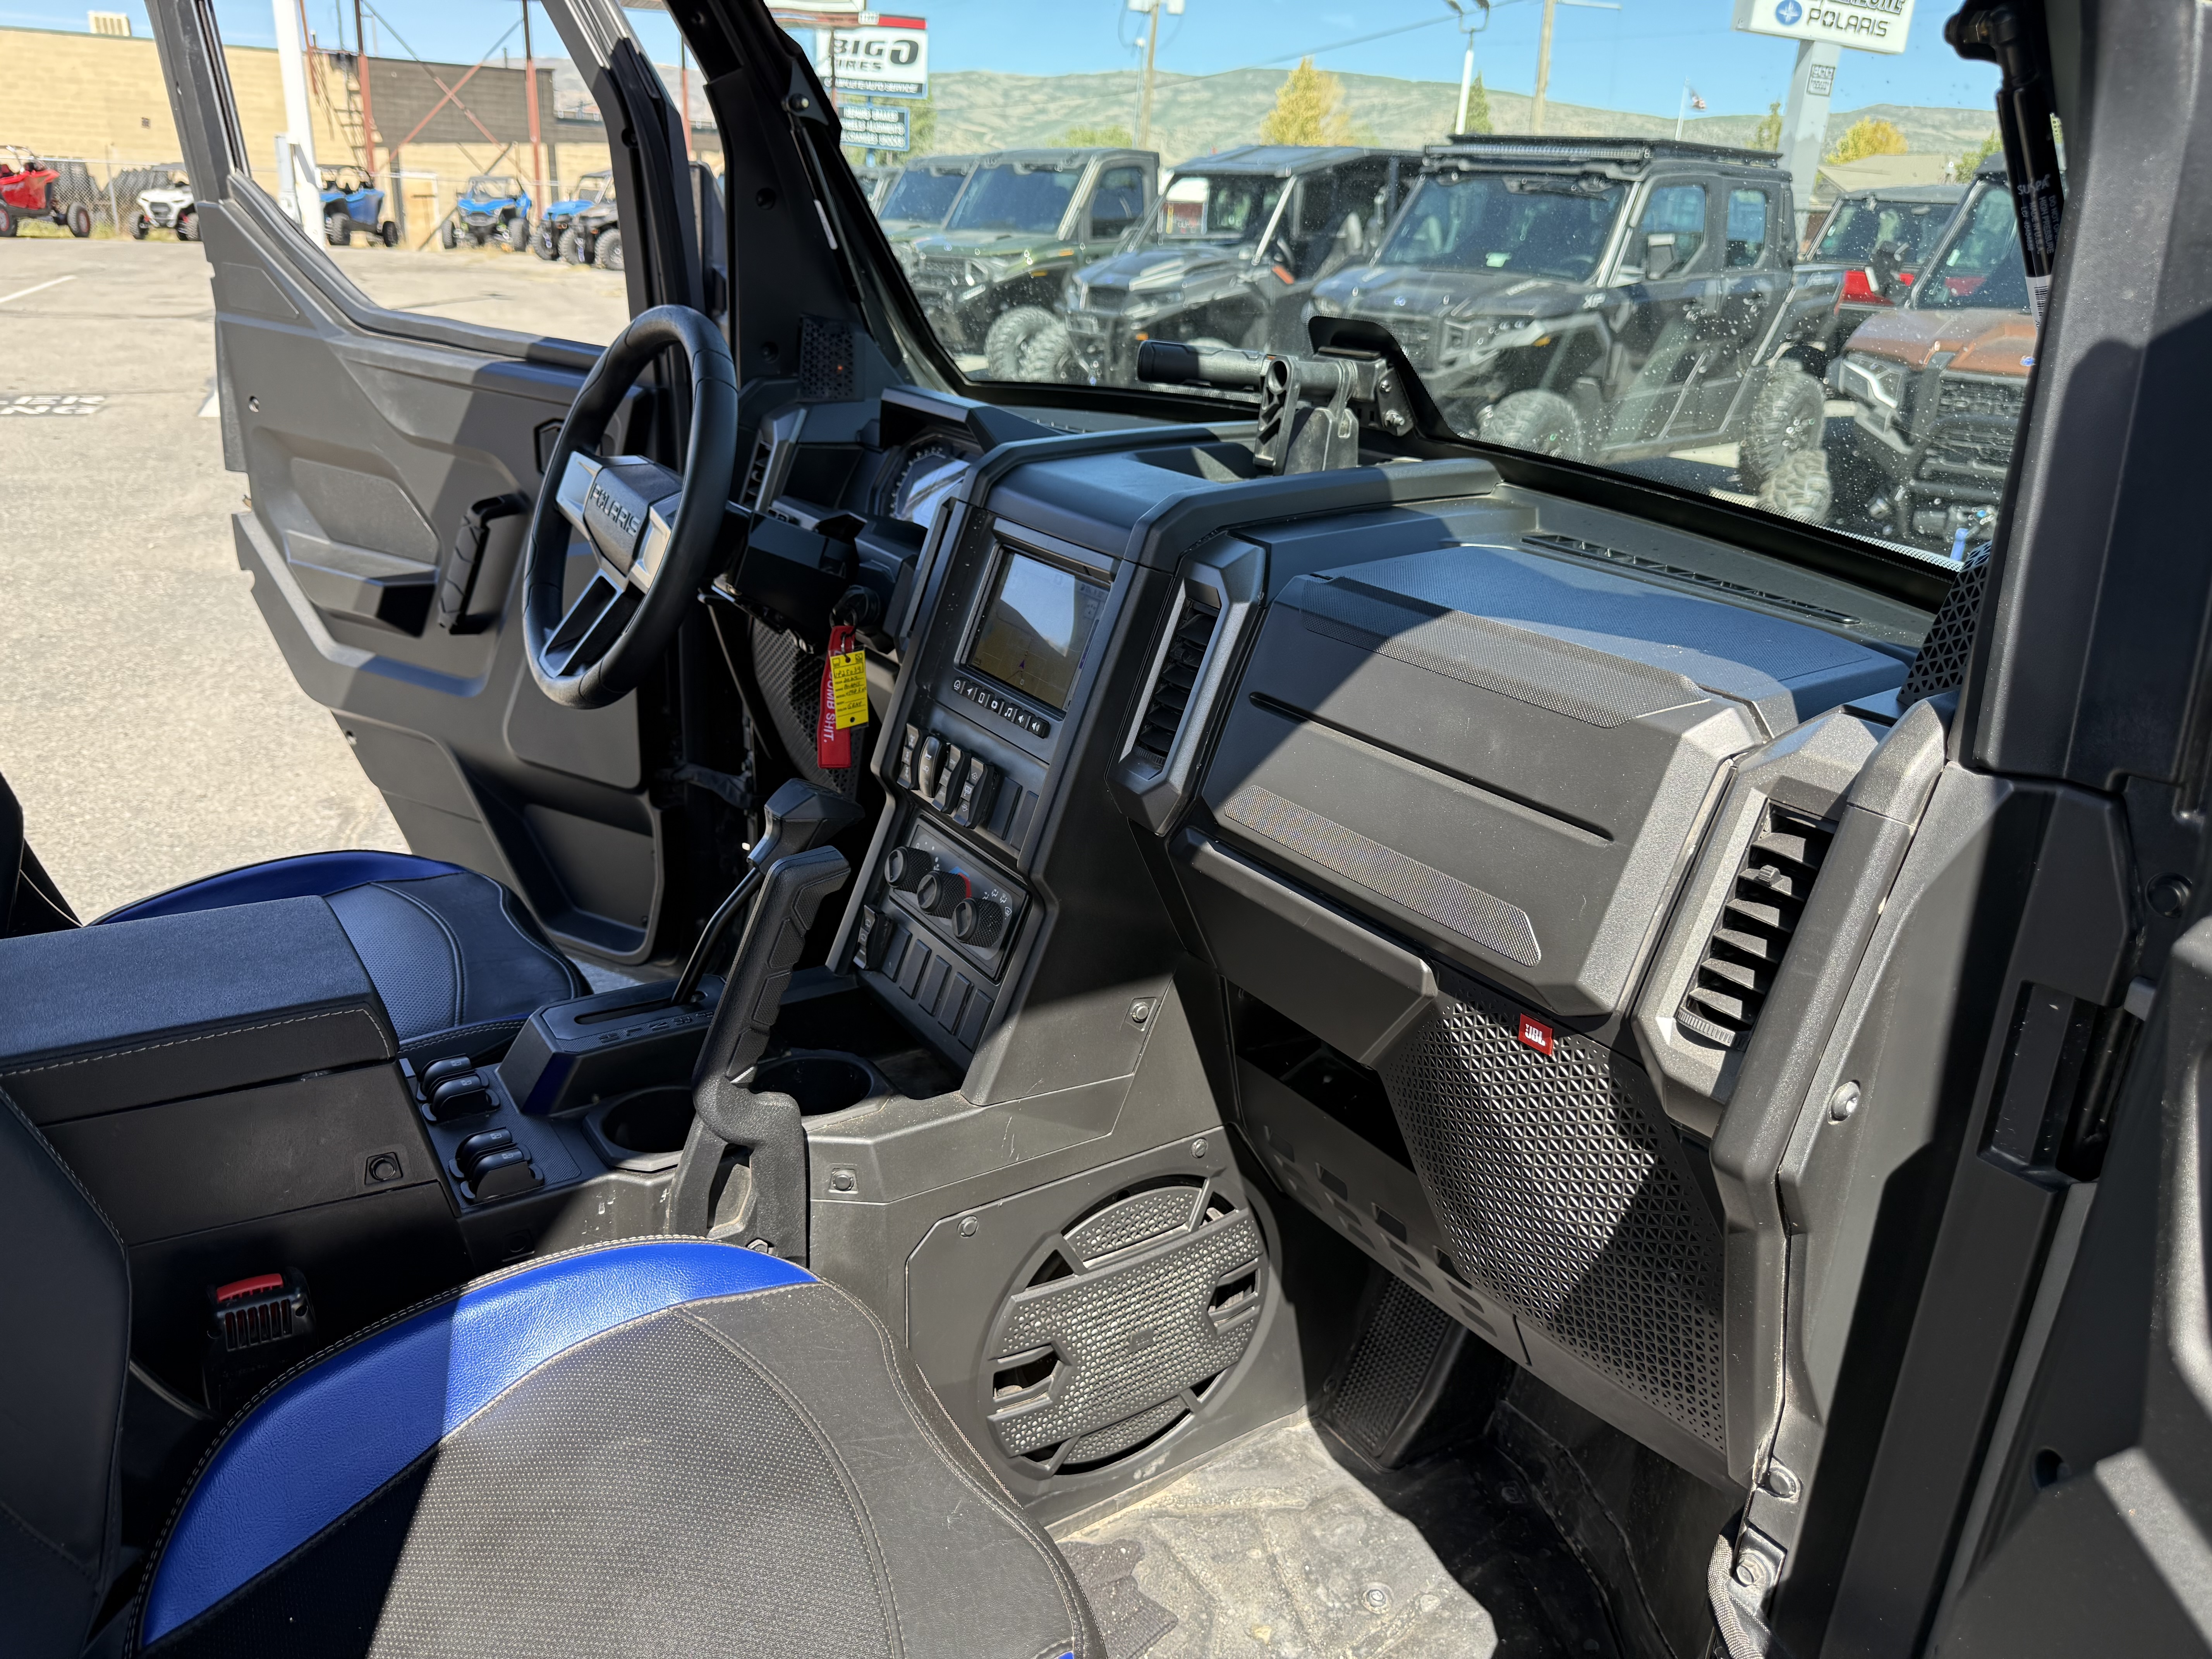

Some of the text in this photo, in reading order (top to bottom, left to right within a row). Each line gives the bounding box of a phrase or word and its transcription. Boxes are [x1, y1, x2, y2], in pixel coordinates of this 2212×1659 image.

[1807, 8, 1888, 37] POLARIS
[833, 40, 919, 65] BIG O
[834, 59, 882, 71] IRES
[2042, 215, 2054, 254] PRESSURE
[590, 483, 641, 537] POLARIS
[824, 672, 836, 743] UMB SHIT.
[1525, 1024, 1546, 1046] JBL
